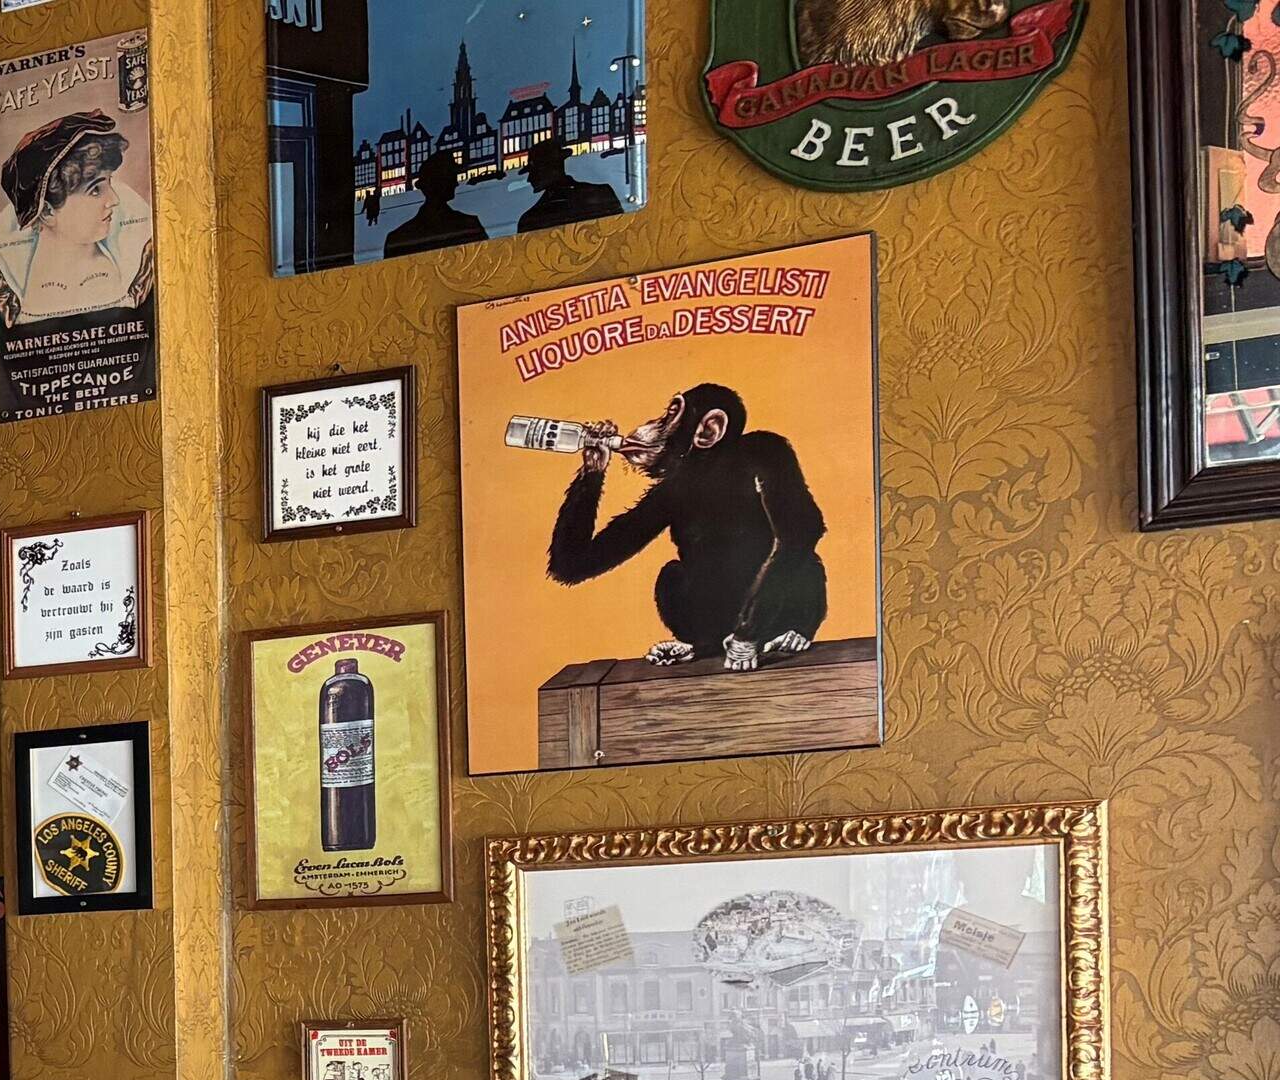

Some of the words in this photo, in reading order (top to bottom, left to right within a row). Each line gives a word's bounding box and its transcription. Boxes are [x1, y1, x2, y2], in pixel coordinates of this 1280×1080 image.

[125, 55, 146, 70] SAFE
[43, 56, 115, 99] YEAST.
[734, 66, 910, 120] CANADIAN
[928, 43, 1038, 75] LAGER
[789, 97, 978, 167] BEER
[500, 284, 630, 353] ANISETTA
[641, 267, 831, 307] EVANGELISTI
[6, 332, 71, 352] WARNER'S
[72, 326, 106, 342] SAFE
[109, 320, 146, 336] CURE
[516, 319, 644, 383] LIQUORE
[645, 321, 672, 342] DA
[672, 305, 817, 338] DESSERT
[11, 361, 75, 381] SATISFACTION
[77, 353, 140, 371] GUARANTEED
[20, 366, 135, 397] TIPPECANOE
[45, 392, 70, 403] THE
[75, 386, 106, 399] BEST
[15, 404, 64, 420] TONIC
[75, 394, 140, 411] BITTERS
[329, 424, 345, 438] die
[296, 446, 327, 461] kleine
[332, 442, 351, 456] niet
[306, 467, 316, 479] is
[344, 460, 372, 478] grote
[313, 486, 332, 500] niet
[61, 558, 92, 572] Zoals
[44, 585, 55, 597] de
[62, 580, 95, 595] waard
[101, 579, 111, 591] is
[40, 604, 94, 618] vertrouwt
[100, 600, 114, 613] bij
[44, 630, 63, 642] zijn
[69, 625, 104, 641] gasten
[287, 632, 406, 674] GENEVER
[324, 733, 372, 773] BOLS
[37, 824, 61, 846] LOS
[61, 818, 108, 845] ANGELES
[102, 842, 119, 887] COUNTY
[333, 857, 370, 871] Lucas
[370, 855, 404, 868] Bols
[44, 858, 89, 892] SHERIFF
